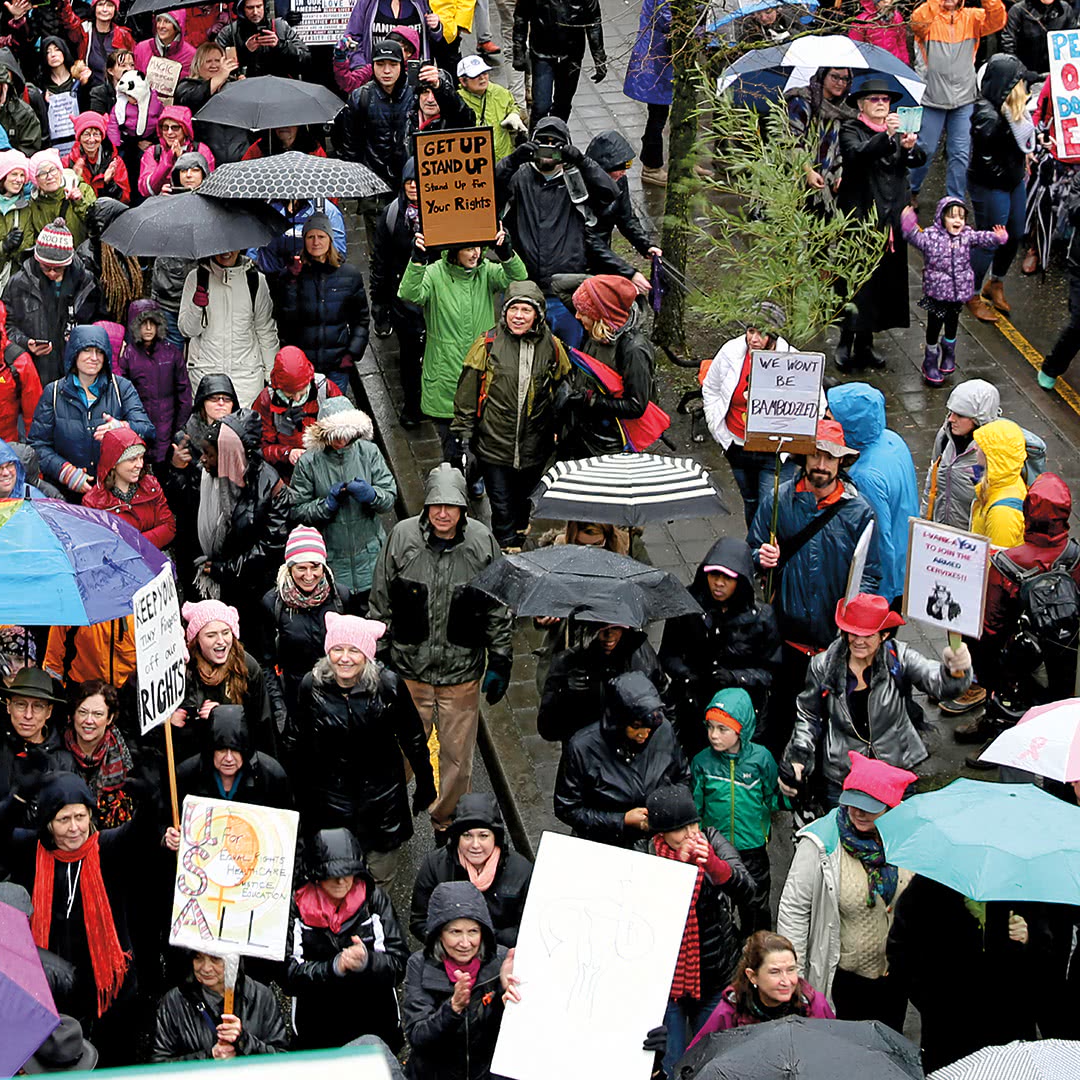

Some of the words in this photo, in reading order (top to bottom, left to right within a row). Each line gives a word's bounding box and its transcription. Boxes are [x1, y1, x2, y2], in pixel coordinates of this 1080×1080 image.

[296, 4, 322, 12] AMERICA
[324, 0, 343, 8] LOVE
[424, 139, 456, 156] GET
[460, 136, 487, 154] UP
[422, 160, 463, 177] STAND
[466, 159, 488, 175] UP
[424, 182, 448, 192] Stand
[454, 180, 466, 191] Up
[426, 200, 450, 214] Your
[455, 196, 491, 212] Rights
[41, 234, 69, 245] ROOTS
[759, 358, 781, 368] WE
[787, 360, 819, 372] WONT
[776, 376, 796, 386] BE
[751, 400, 820, 418] BAMBOOZLED
[926, 542, 936, 552] TO
[937, 546, 956, 558] JOIN
[957, 551, 971, 560] THE
[958, 537, 977, 552] YOU
[932, 556, 962, 568] ARMED
[135, 590, 158, 628] KEEP
[158, 573, 175, 611] YOUR
[140, 629, 156, 646] TINY
[145, 654, 159, 674] off
[164, 642, 177, 660] our
[140, 659, 184, 724] RIGHTS
[220, 851, 251, 862] EQUAL
[254, 854, 286, 864] RIGHTS
[242, 888, 287, 900] EDUCATION
